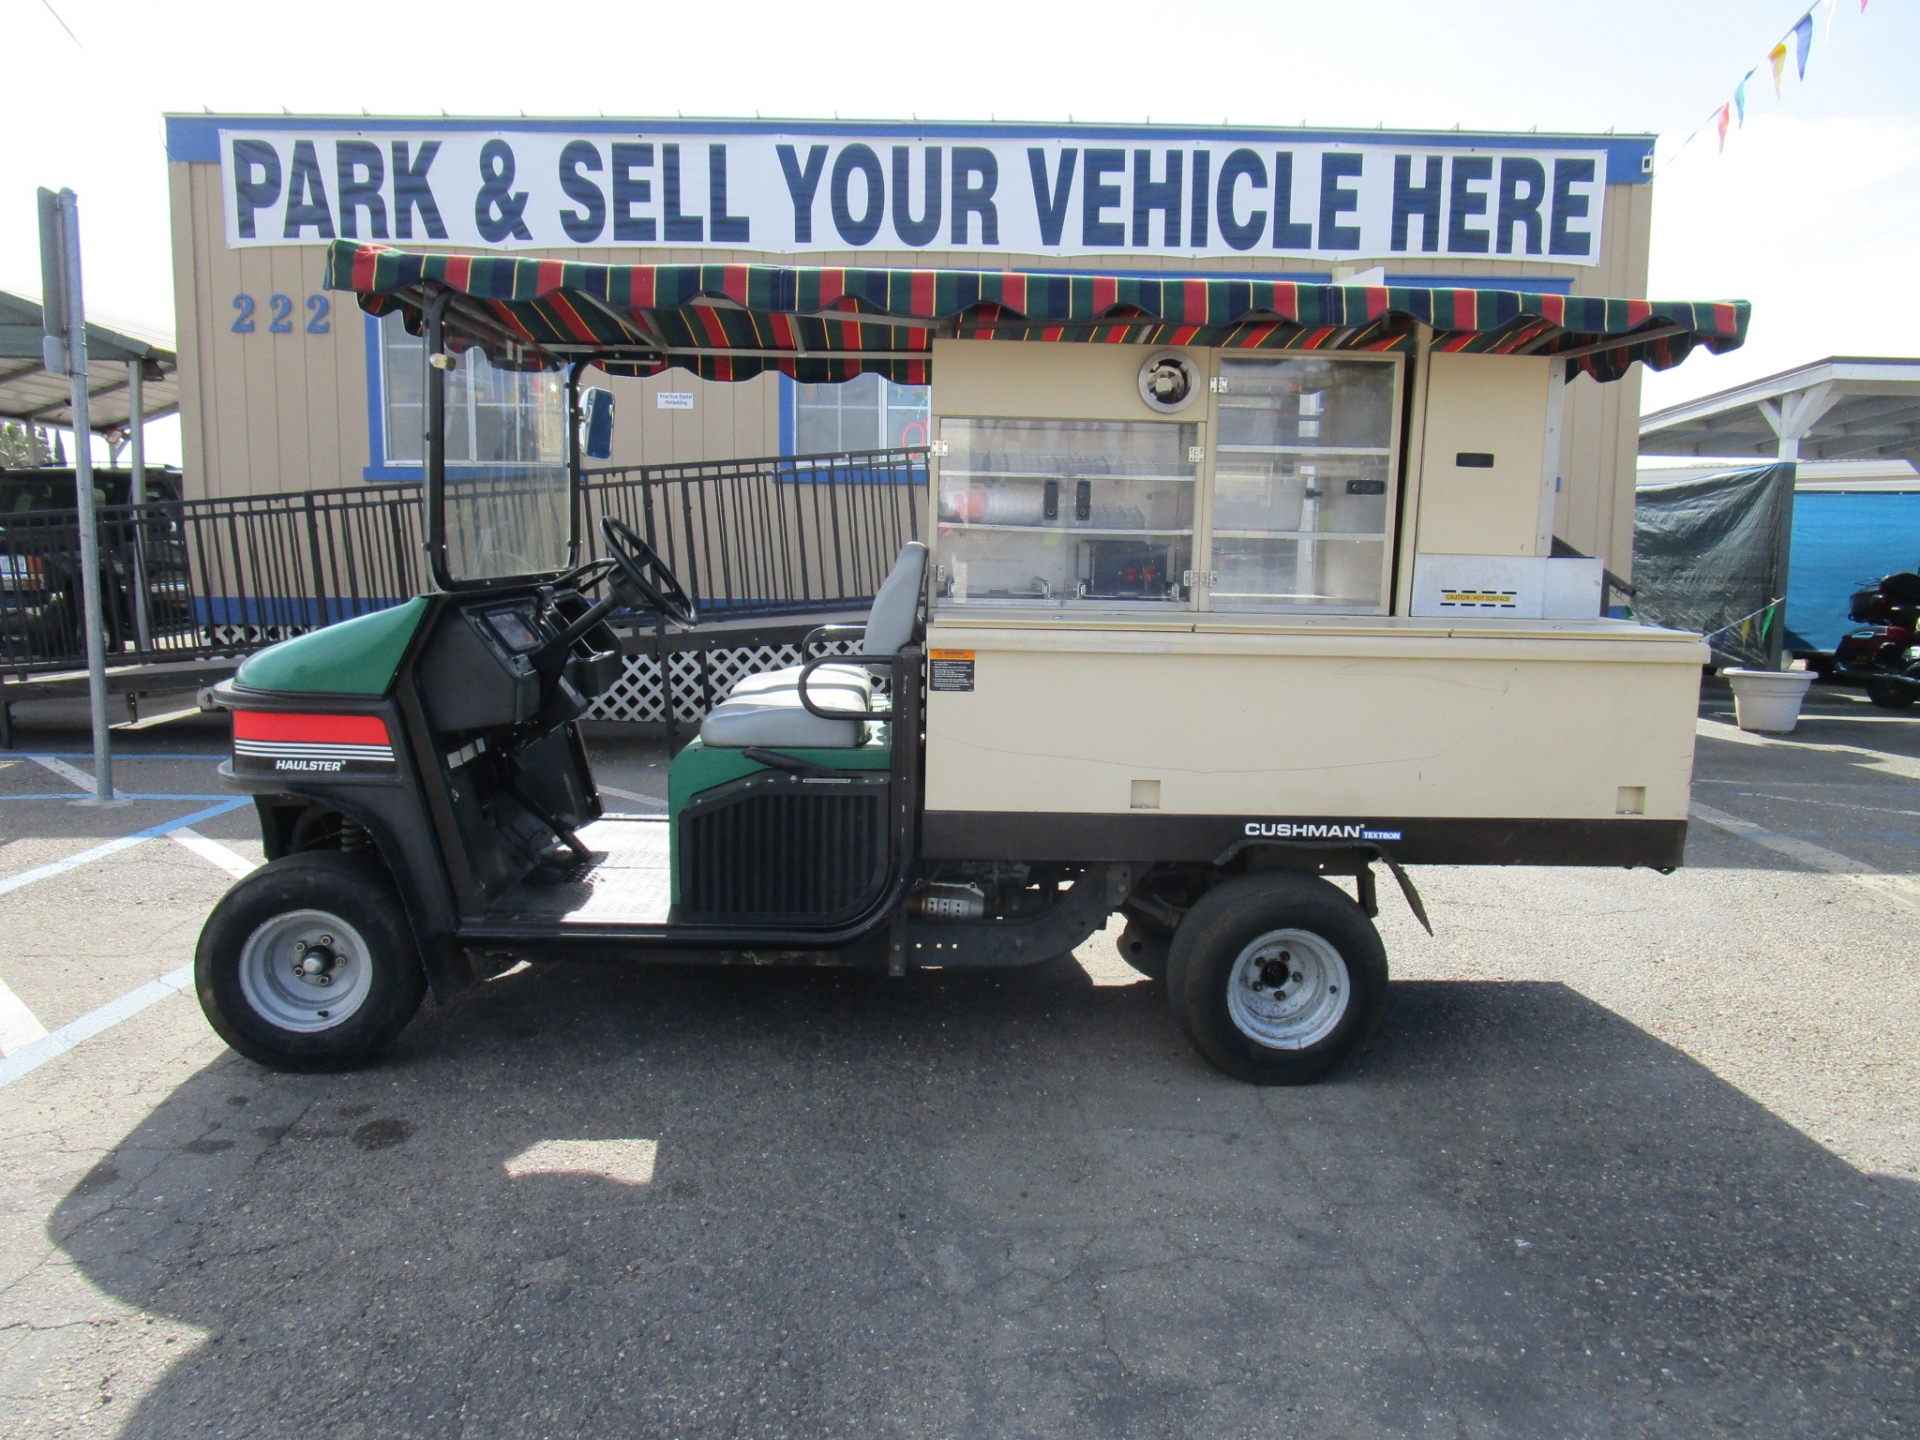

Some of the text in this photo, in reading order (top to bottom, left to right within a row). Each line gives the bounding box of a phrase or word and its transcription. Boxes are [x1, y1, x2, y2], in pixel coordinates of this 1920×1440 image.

[232, 138, 1596, 256] PARK & SELL YOUR VEHICLE HERE
[231, 293, 331, 334] 222
[275, 759, 342, 772] HAULSTER
[1244, 822, 1401, 840] CUSHMAN TEXTRON
